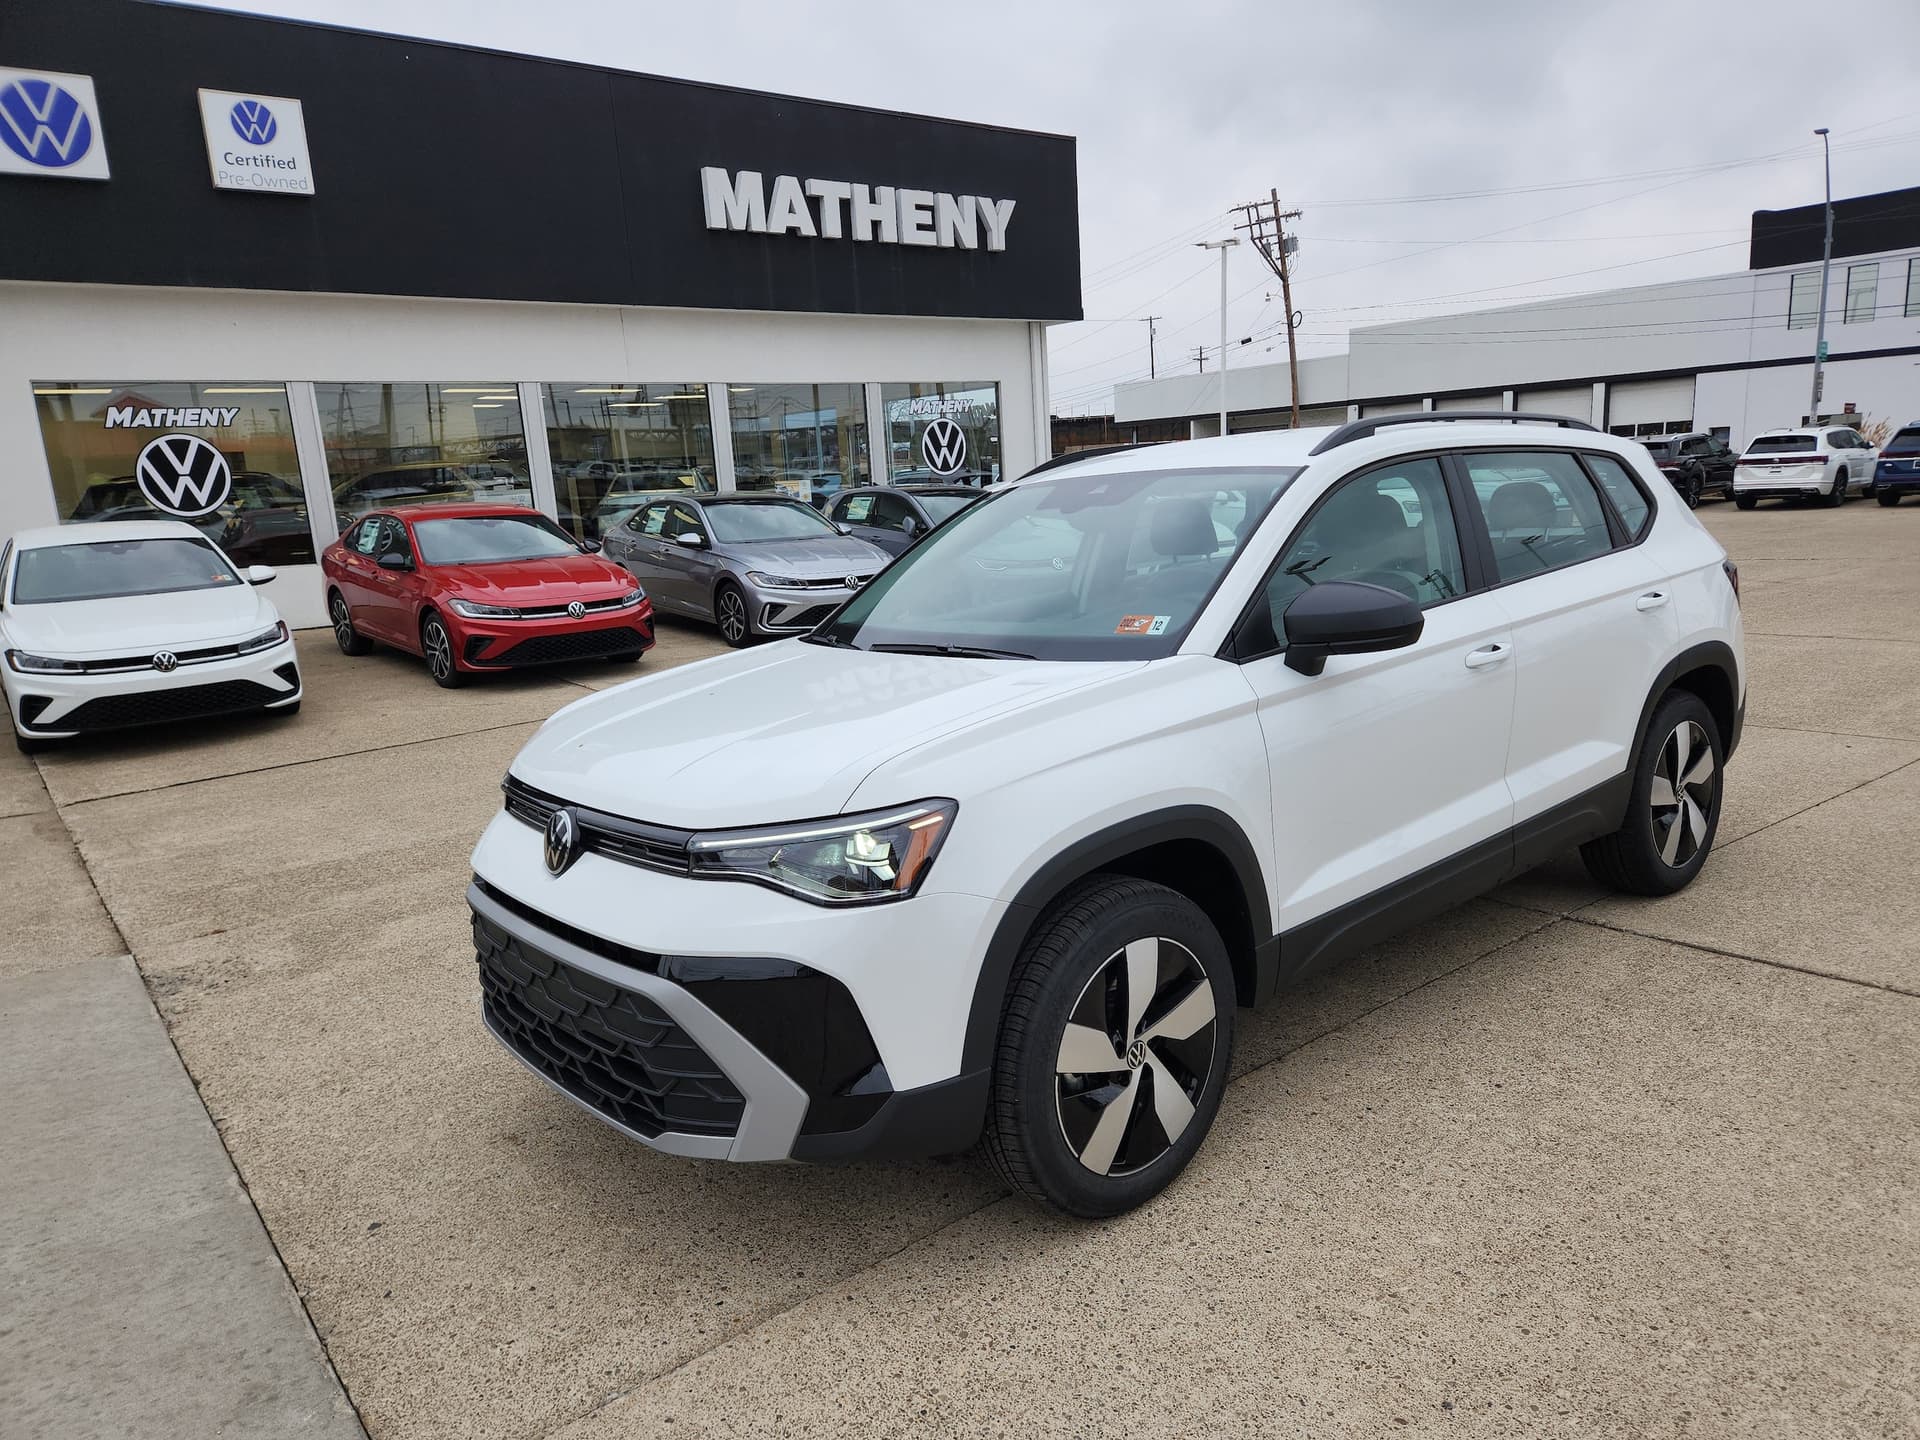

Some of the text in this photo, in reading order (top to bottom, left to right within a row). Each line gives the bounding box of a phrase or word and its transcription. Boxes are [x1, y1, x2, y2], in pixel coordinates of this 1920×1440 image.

[223, 151, 297, 171] Certified
[218, 170, 309, 191] Pre-Owned
[701, 166, 1017, 252] MATHENY
[105, 406, 240, 428] MATHENY
[909, 399, 974, 415] MATHENY
[922, 418, 966, 476] VW
[136, 433, 231, 518] VW
[1152, 620, 1164, 631] 12
